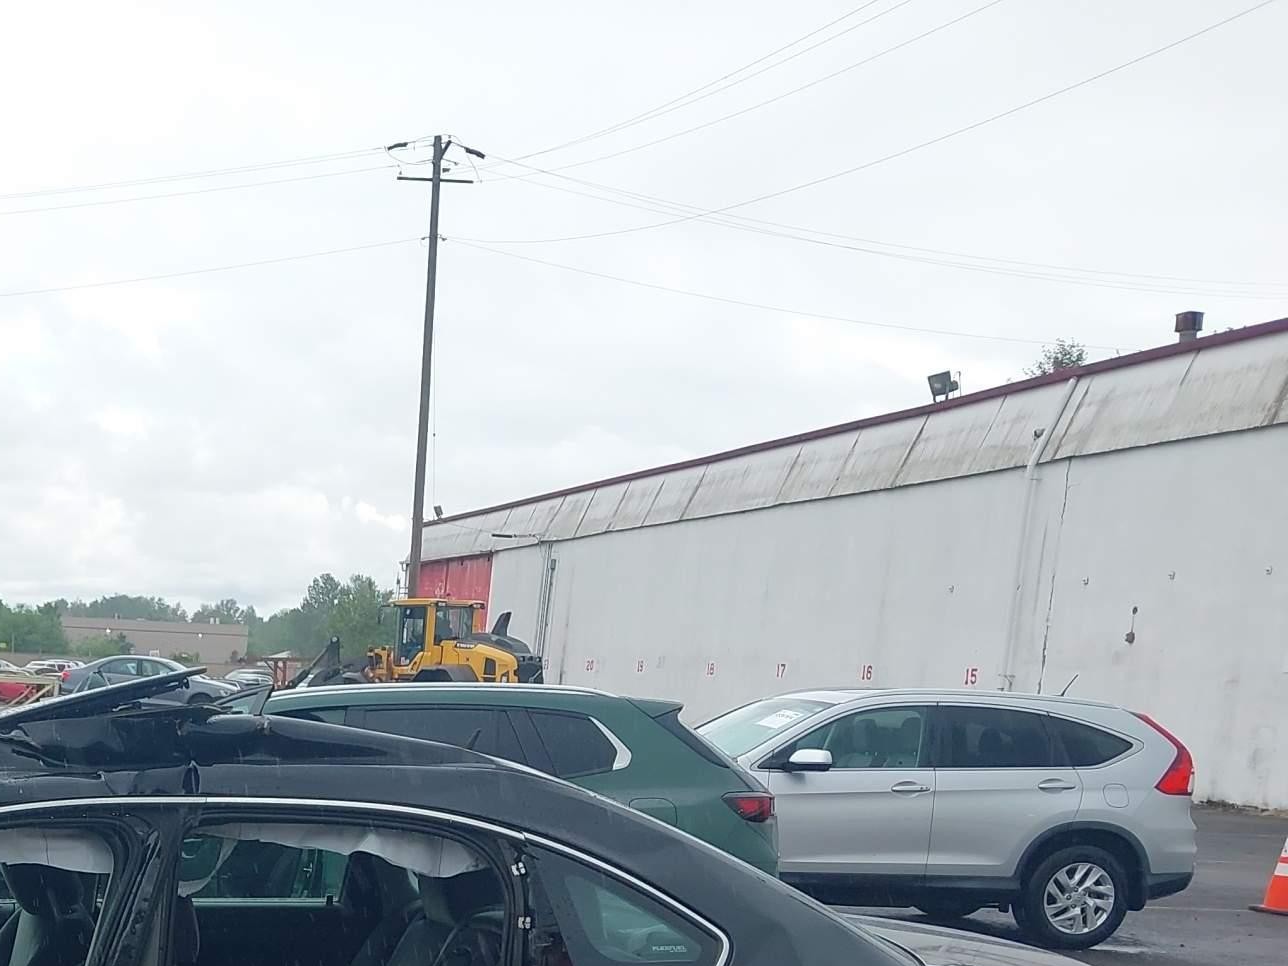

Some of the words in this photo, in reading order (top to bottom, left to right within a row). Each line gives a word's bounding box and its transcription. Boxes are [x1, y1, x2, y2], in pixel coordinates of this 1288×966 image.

[586, 660, 594, 671] 20
[637, 660, 644, 672] 19
[706, 663, 715, 675] 18
[776, 663, 787, 678] 17
[862, 665, 873, 680] 16
[964, 668, 978, 685] 15
